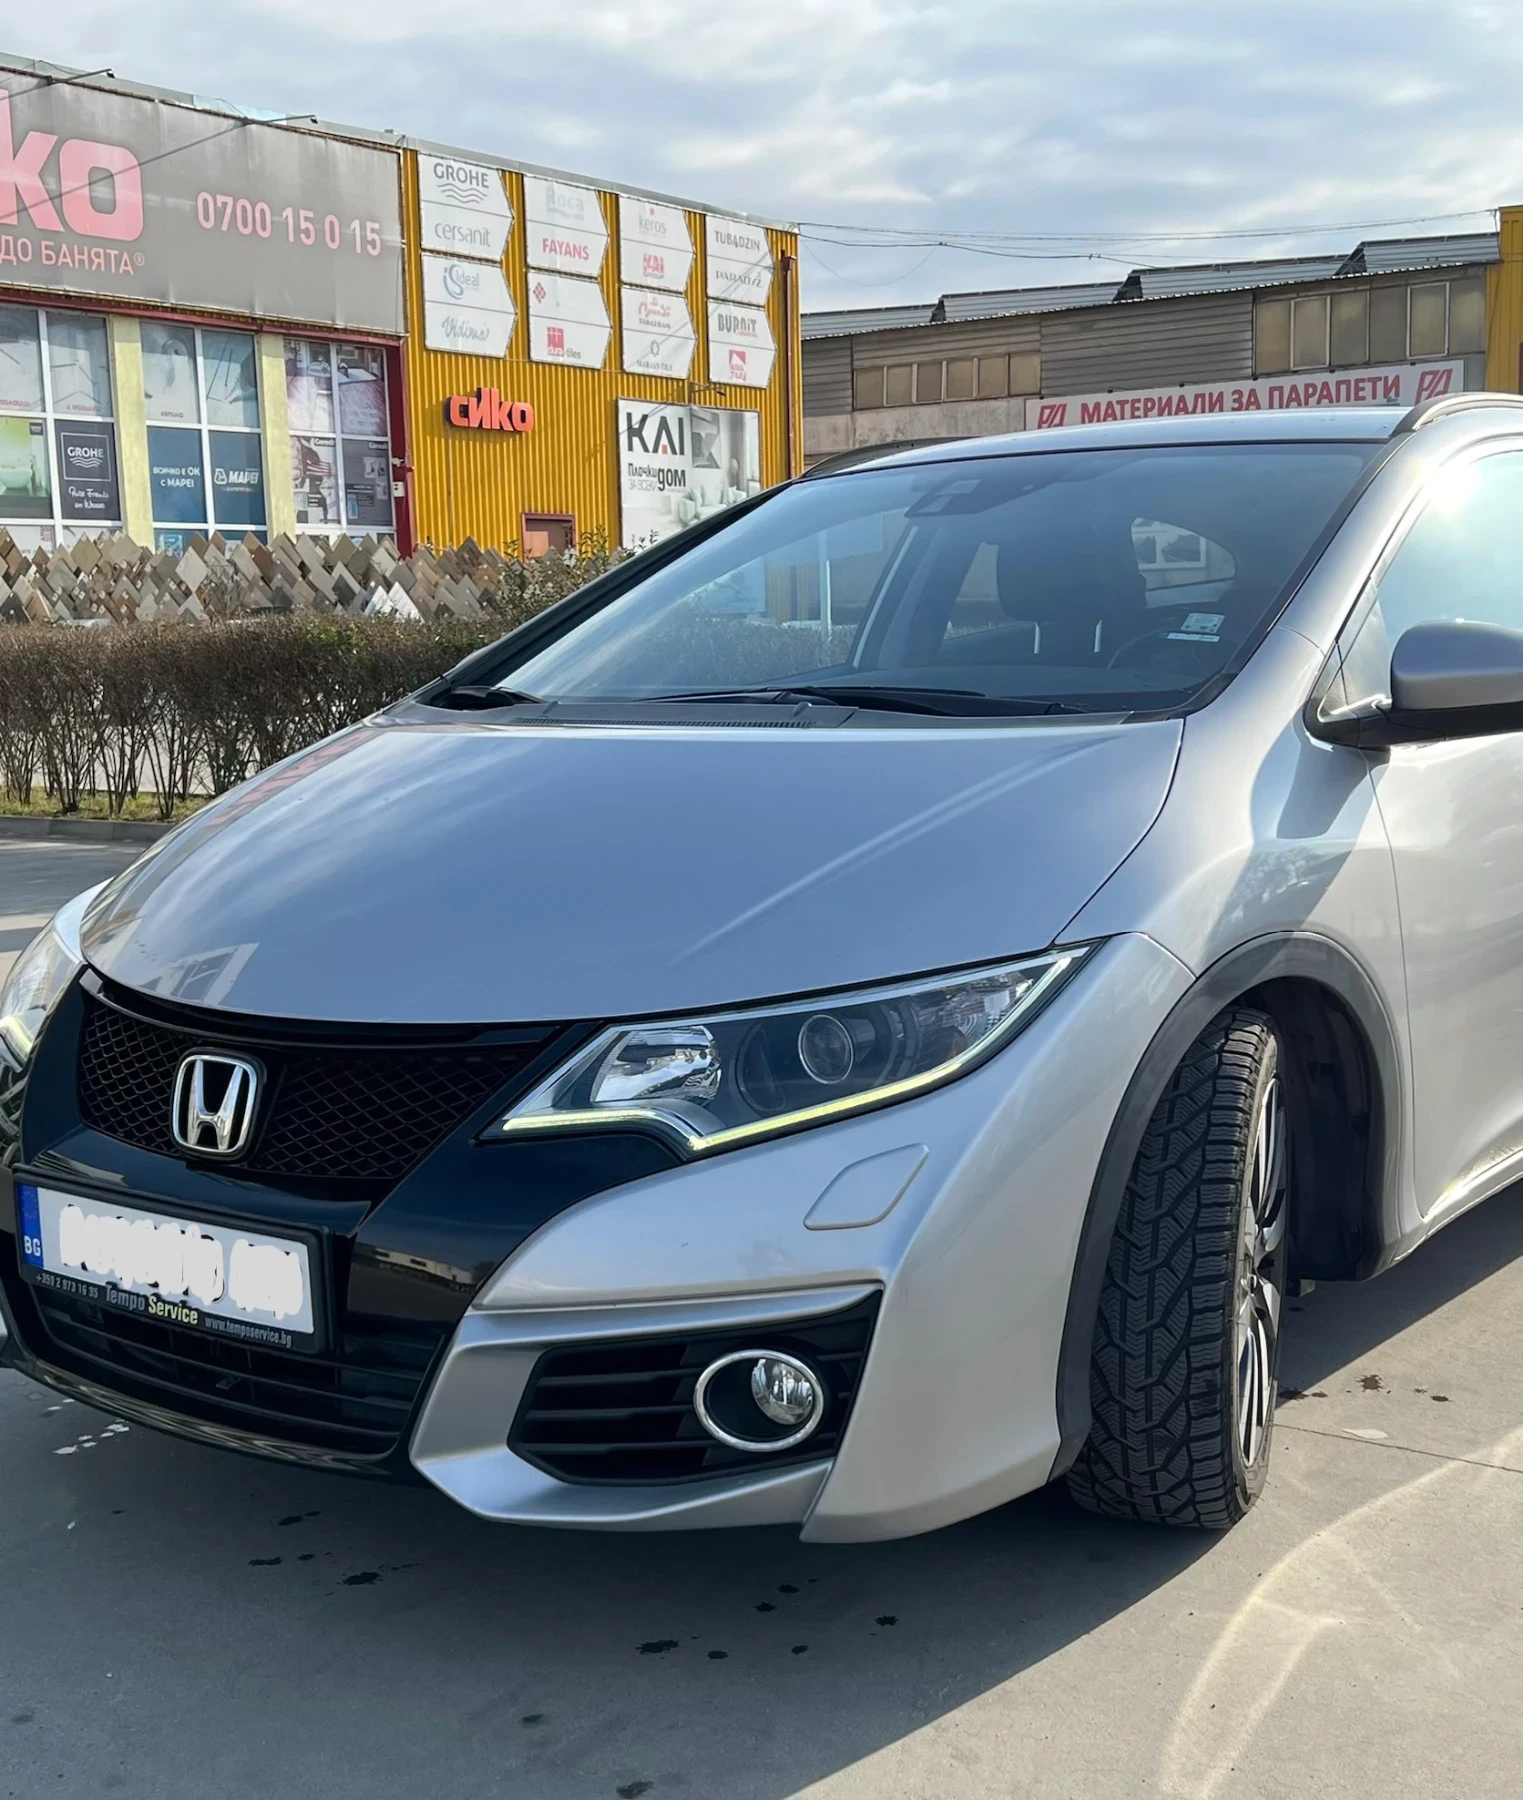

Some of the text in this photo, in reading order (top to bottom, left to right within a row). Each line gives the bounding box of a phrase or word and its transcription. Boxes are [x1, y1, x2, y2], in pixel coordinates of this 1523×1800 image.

[433, 162, 490, 189] GROHE
[197, 191, 382, 257] 0700 15 0 15
[434, 222, 491, 248] cersanit
[638, 213, 667, 235] keros
[542, 238, 589, 261] FAYANS
[1080, 390, 1225, 425] МАТЕРИАЛИ
[1230, 388, 1261, 411] ЗА
[1268, 374, 1401, 409] ПАРАПЕТИ
[626, 412, 685, 456] KAI
[67, 446, 104, 458] GROHE
[166, 478, 195, 488] MAPEI
[228, 470, 259, 484] MAPEI
[23, 1235, 41, 1256] BG
[105, 1284, 199, 1325] Tempo Service
[204, 1316, 292, 1349] www.temposervice.bg
